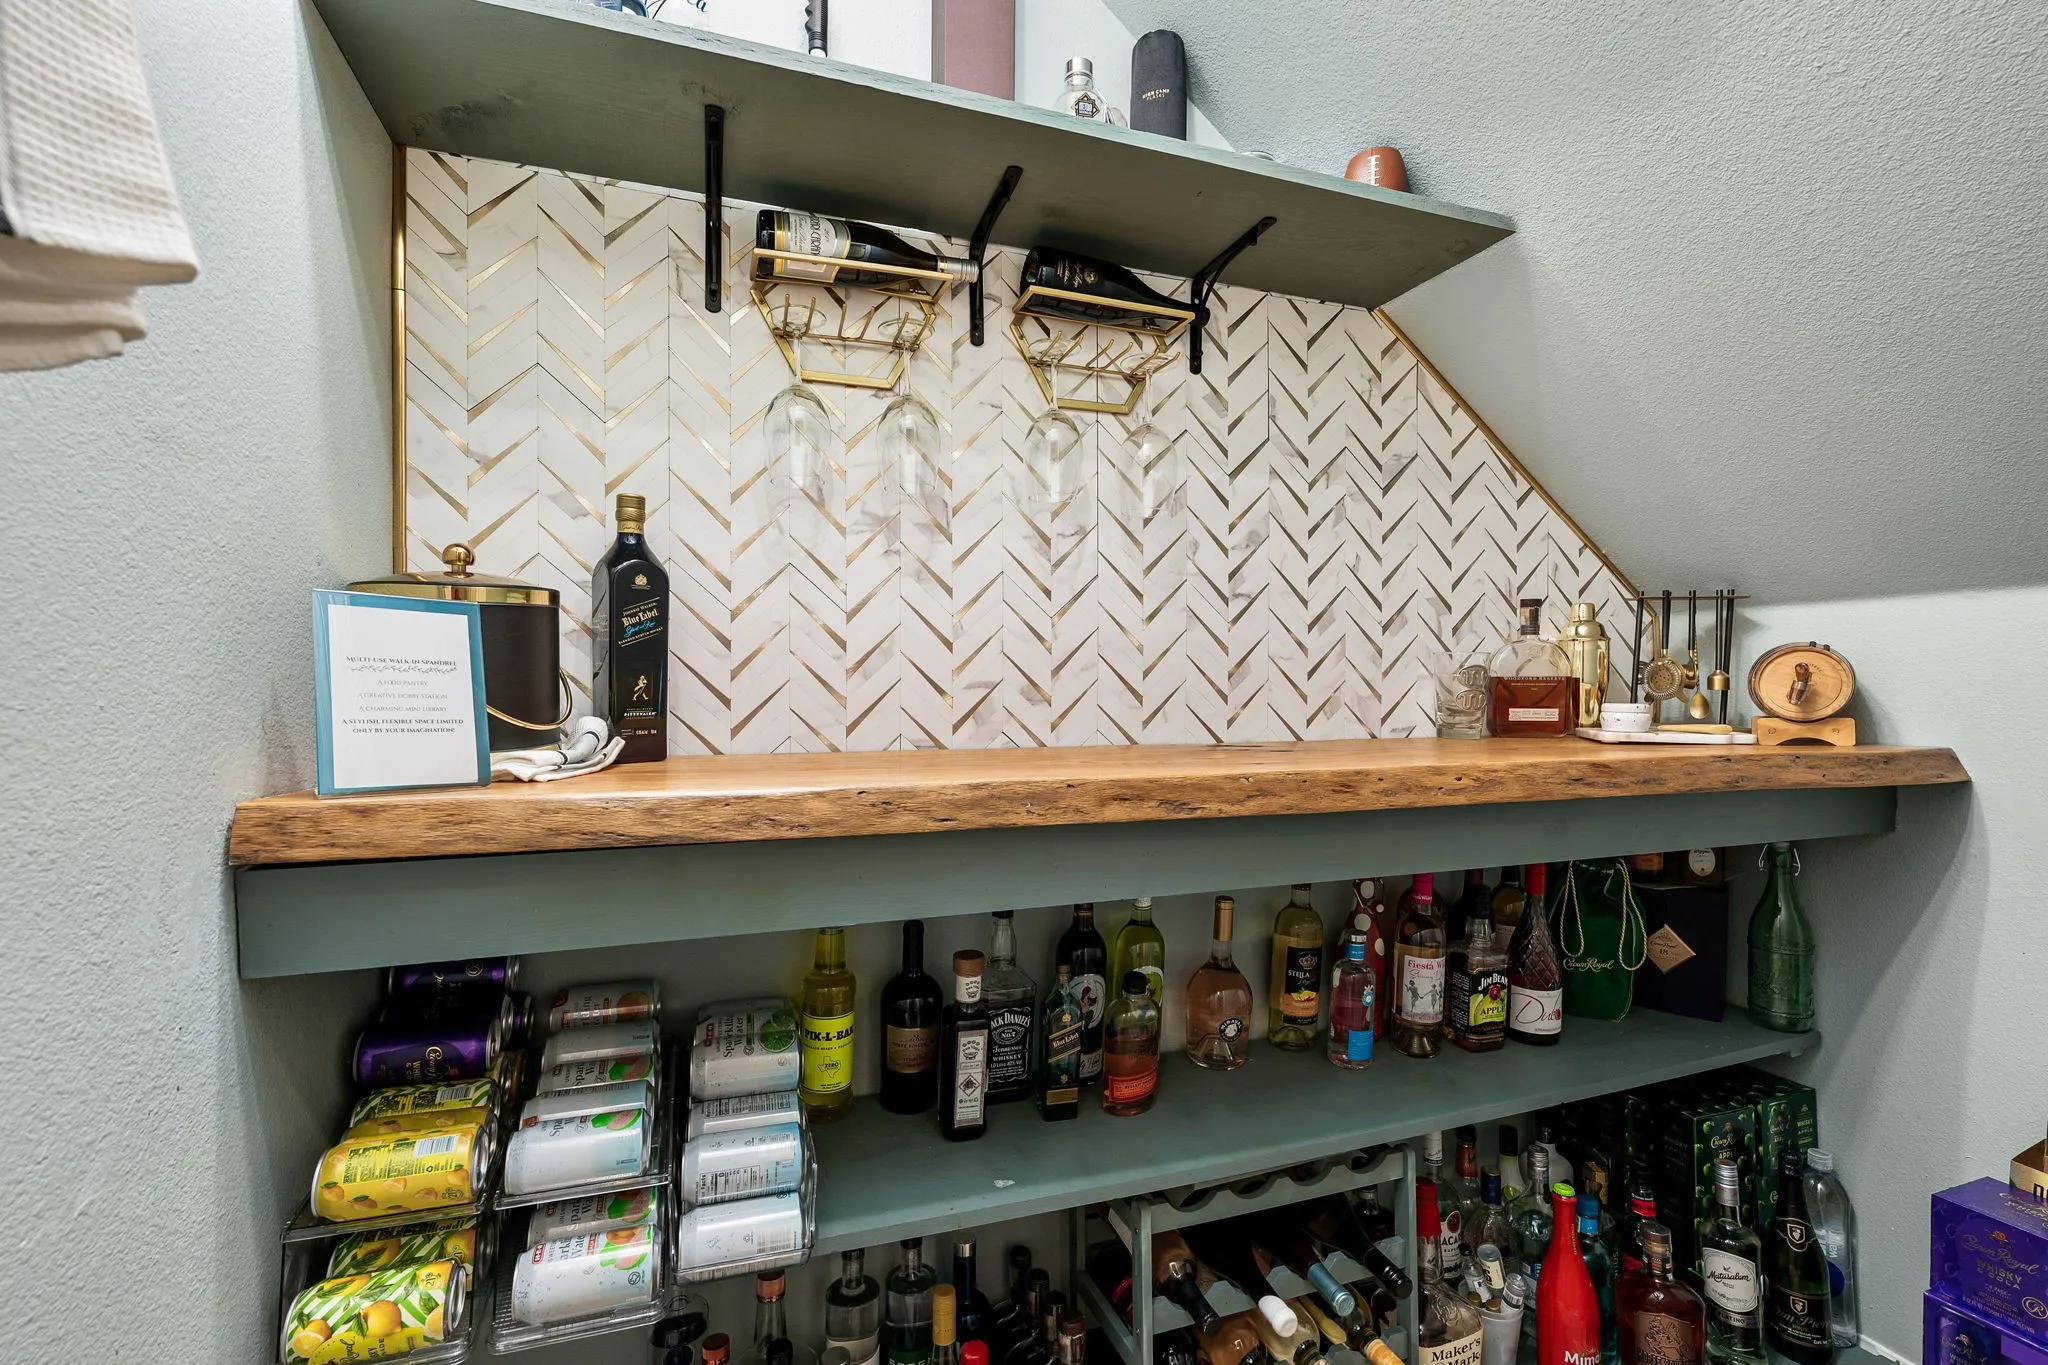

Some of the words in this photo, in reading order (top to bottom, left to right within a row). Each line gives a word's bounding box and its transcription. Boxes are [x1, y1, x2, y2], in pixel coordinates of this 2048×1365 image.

[1142, 91, 1155, 99] HIGH
[621, 616, 640, 627] Blue
[638, 608, 658, 621] Label
[623, 607, 640, 616] JOHNNIE
[618, 635, 636, 644] BLENDED
[635, 631, 650, 639] SCOTCH
[649, 626, 663, 634] WHISKY
[345, 655, 386, 663] MULTI-USE
[363, 692, 396, 700] CREATIVE
[420, 693, 448, 701] STATION
[364, 705, 404, 713] CHARMING
[352, 727, 373, 735] ONLY
[374, 727, 384, 735] BY
[384, 727, 406, 735] YOUR
[1407, 959, 1434, 970] Fiesta
[1562, 957, 1588, 971] Crown
[1584, 956, 1615, 973] Royal
[1478, 976, 1492, 991] JIM
[990, 1016, 1004, 1031] ACK
[1004, 1011, 1031, 1029] DANIEL'S
[993, 1053, 1022, 1062] WHISKEY
[1960, 1233, 2000, 1261] Crown
[1989, 1248, 2041, 1276] Royal
[1976, 1258, 2023, 1284] WHISKY
[1987, 1271, 2021, 1290] COLA
[1430, 1337, 1481, 1363] Maker's
[1446, 1351, 1481, 1365] Mark
